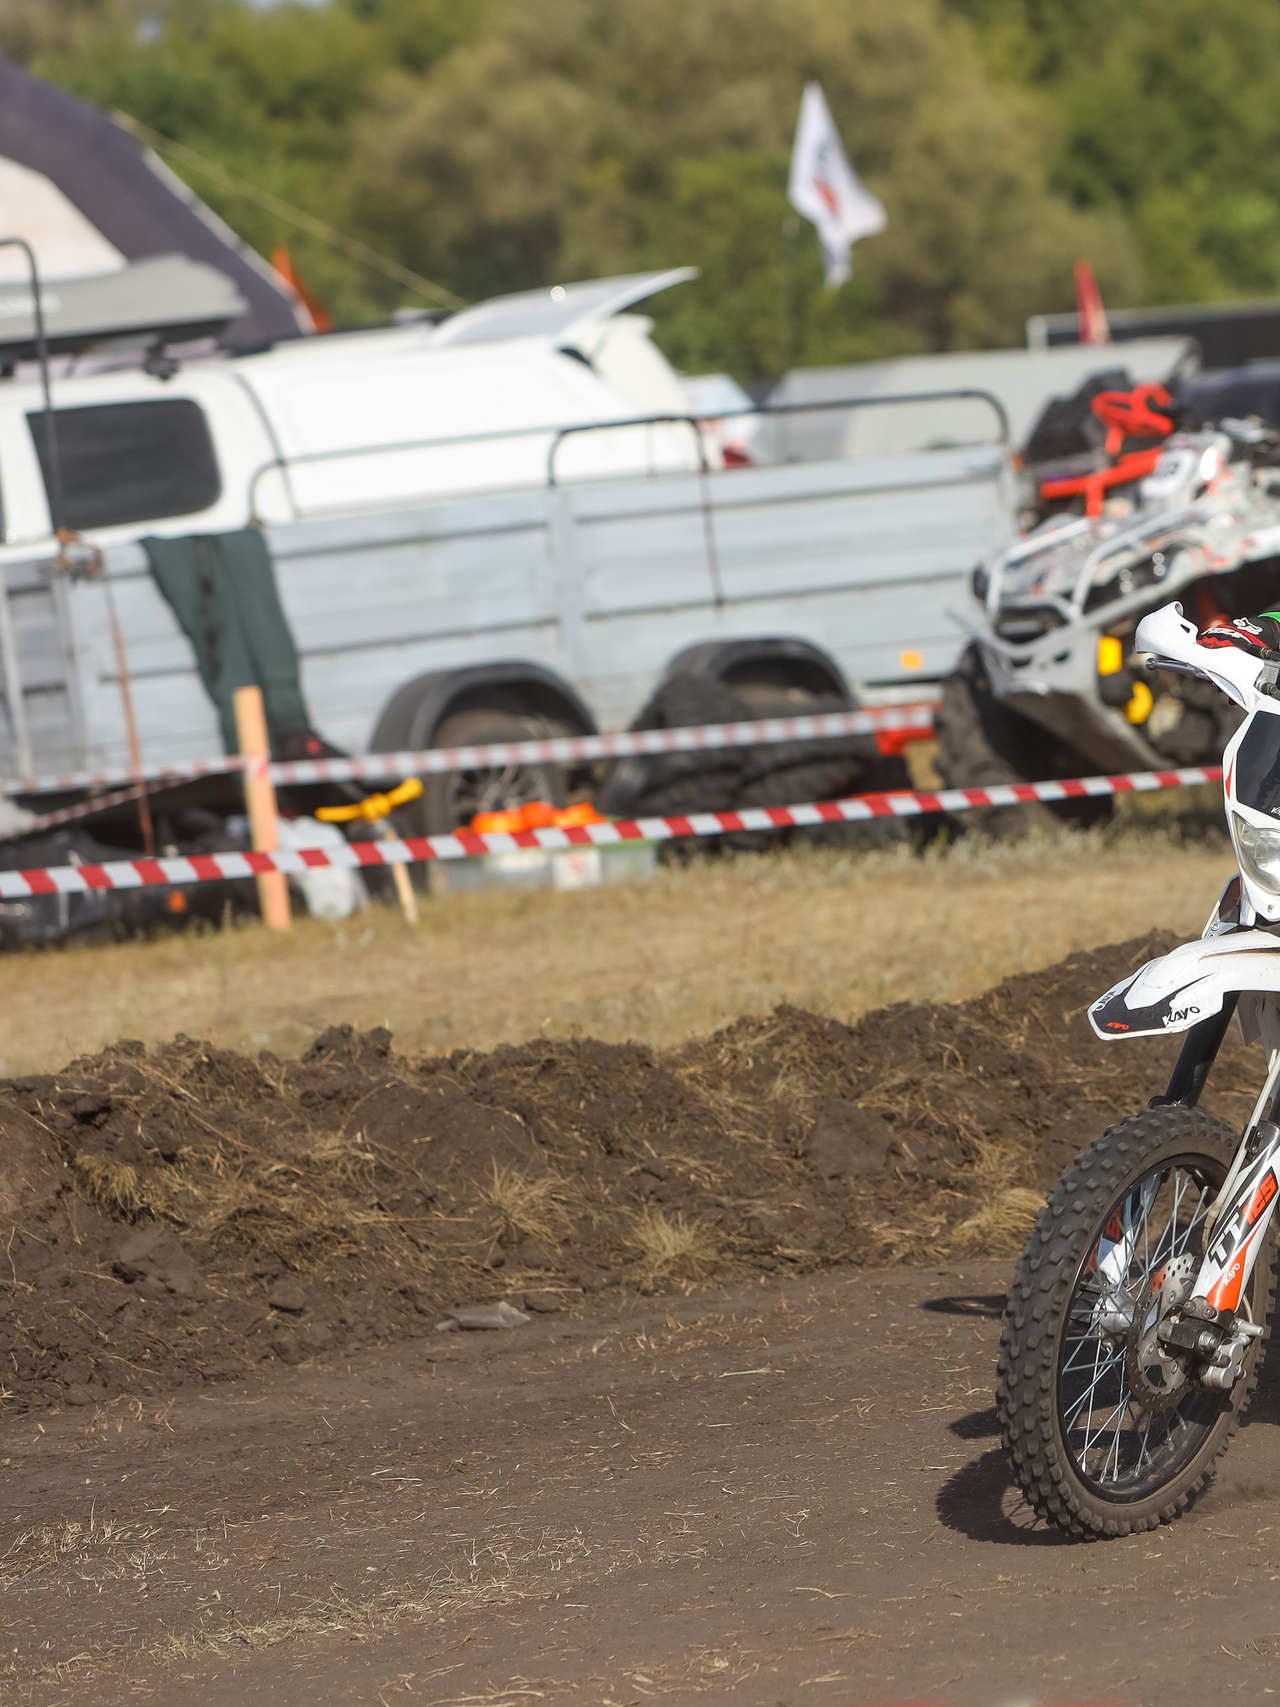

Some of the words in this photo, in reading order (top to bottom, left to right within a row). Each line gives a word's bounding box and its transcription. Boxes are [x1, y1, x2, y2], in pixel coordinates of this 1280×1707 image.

[1162, 1006, 1201, 1028] KAYO
[1209, 1212, 1243, 1264] TT
[1241, 1172, 1279, 1226] 125
